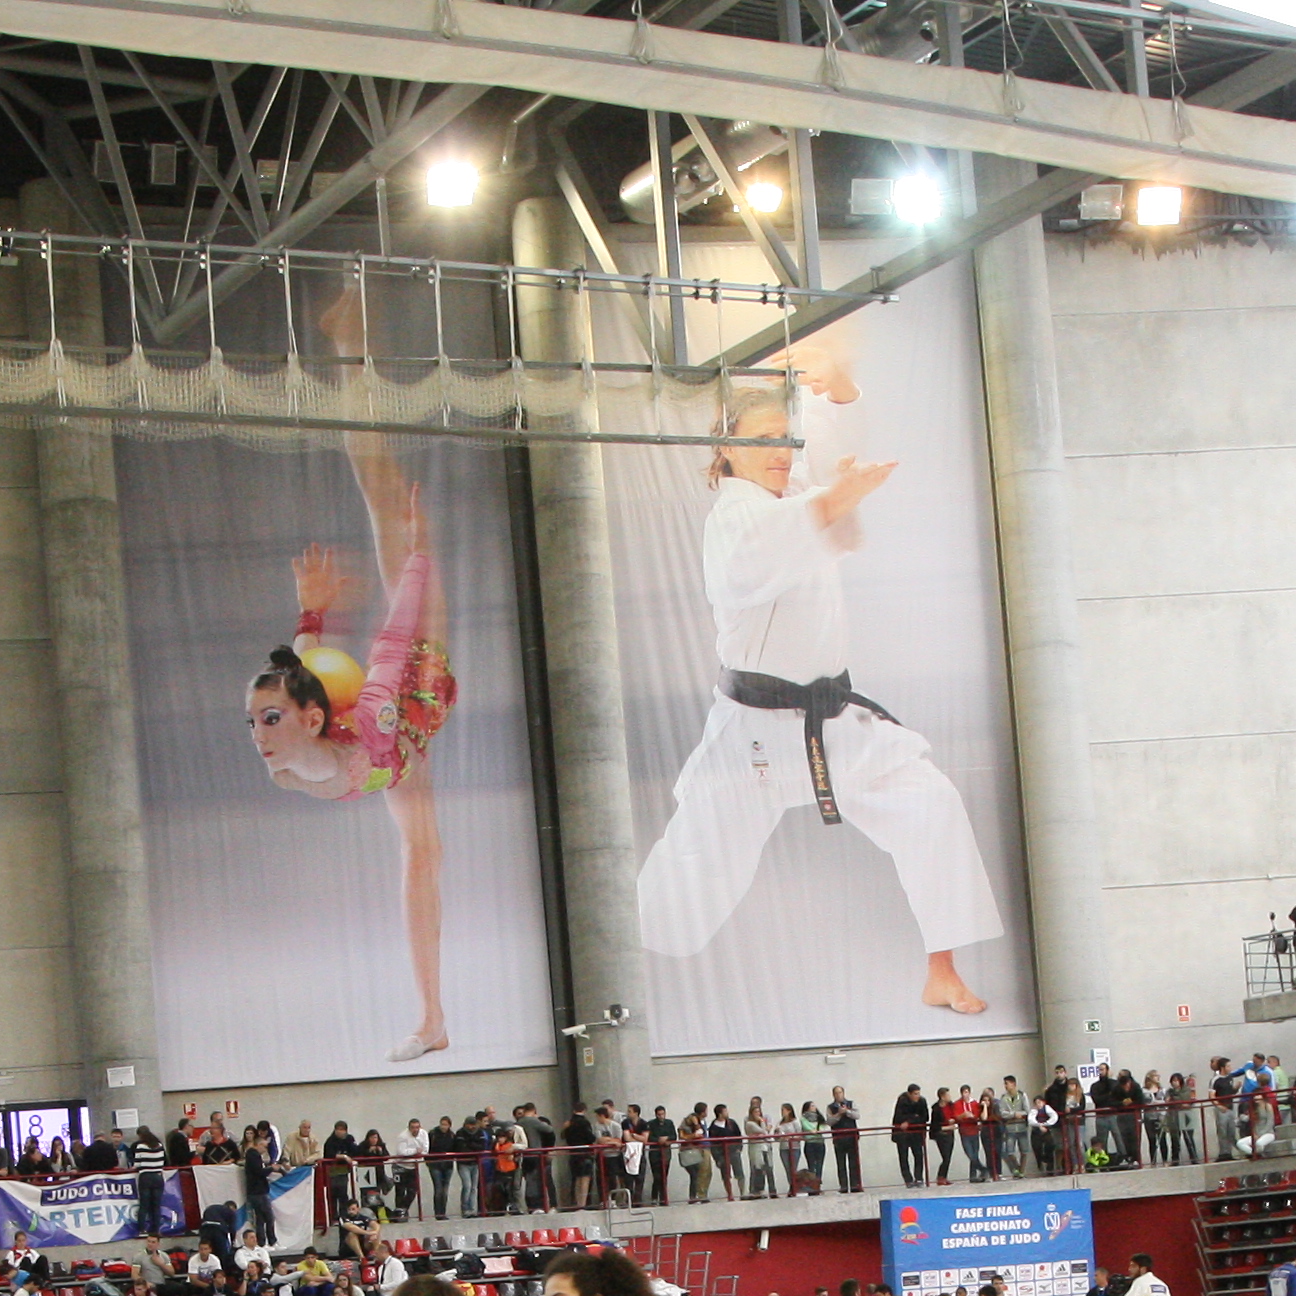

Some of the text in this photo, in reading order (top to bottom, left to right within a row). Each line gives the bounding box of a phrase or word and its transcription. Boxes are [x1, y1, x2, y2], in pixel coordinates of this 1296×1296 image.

[47, 1183, 134, 1201] JUDO CLUB
[955, 1205, 1021, 1219] FASE FINAL
[950, 1218, 1031, 1234] CAMPEONATO
[942, 1234, 988, 1249] ESPAÑA
[991, 1235, 1006, 1246] DE
[1009, 1232, 1041, 1245] JUDO
